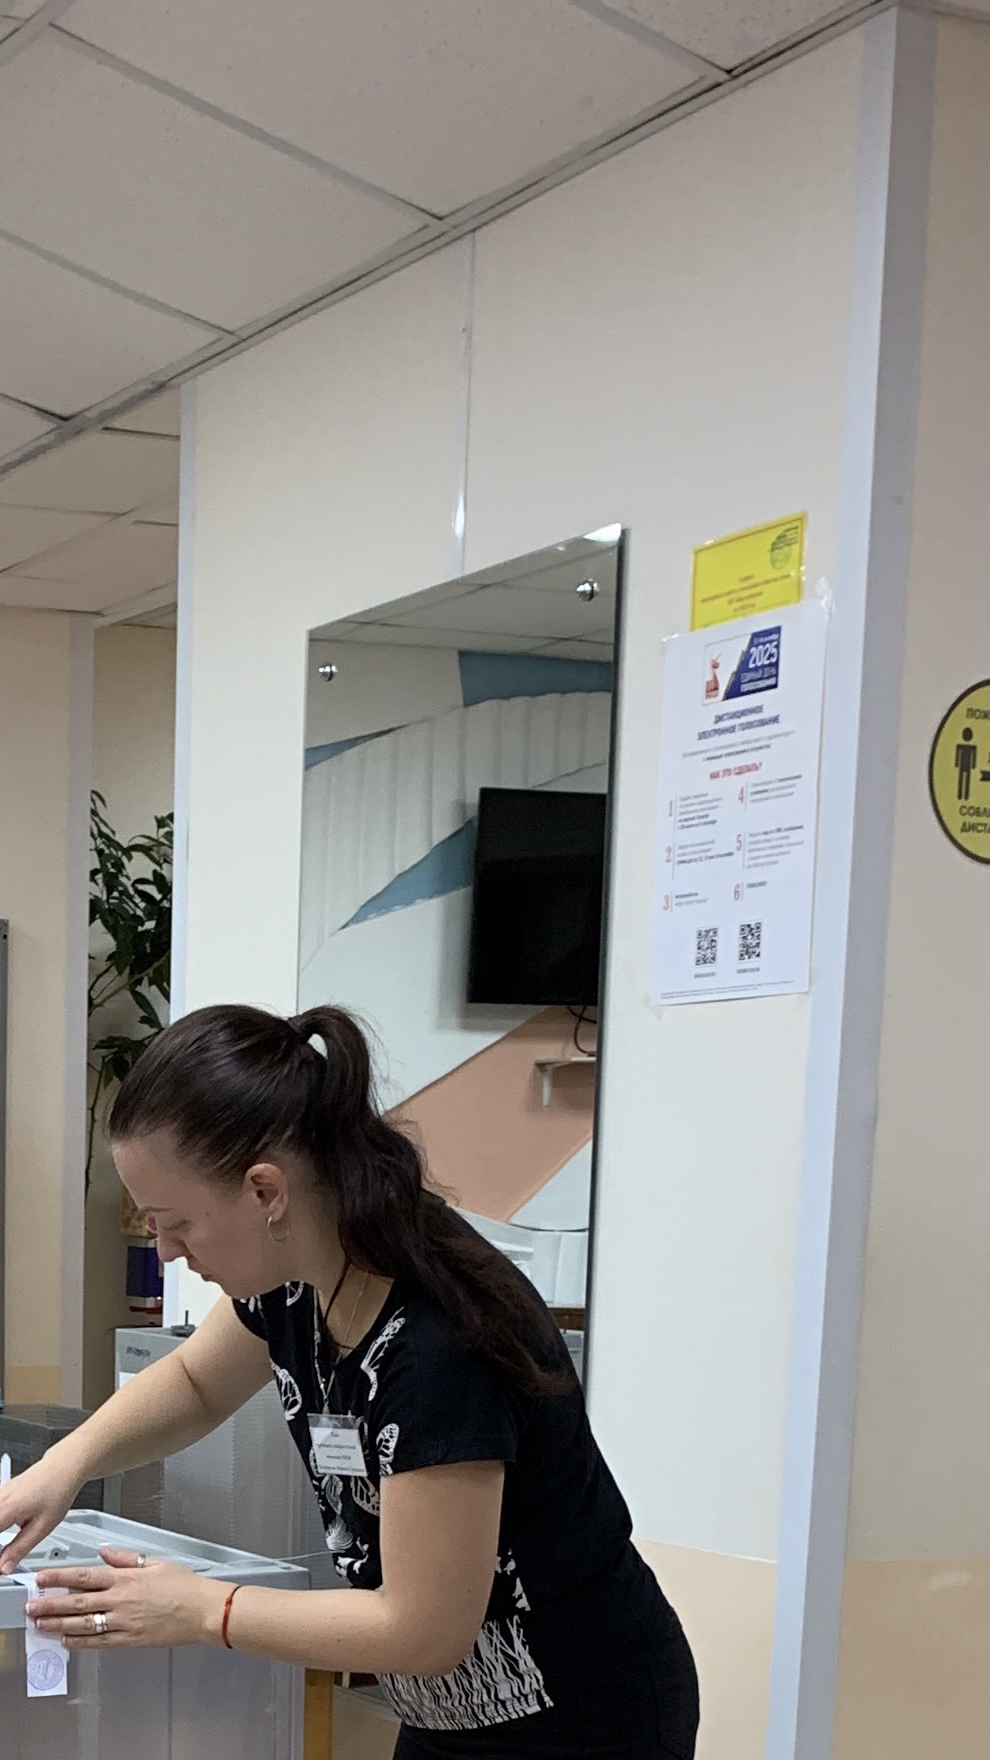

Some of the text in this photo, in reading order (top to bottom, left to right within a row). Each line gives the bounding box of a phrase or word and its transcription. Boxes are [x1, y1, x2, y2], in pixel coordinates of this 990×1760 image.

[748, 641, 779, 669] 2025
[966, 708, 990, 720] ПОЖ
[738, 786, 745, 804] 4
[959, 805, 990, 818] СОБЛ
[735, 833, 742, 852] 5
[665, 846, 672, 863] 2
[733, 883, 741, 901] 6
[663, 894, 670, 911] 3
